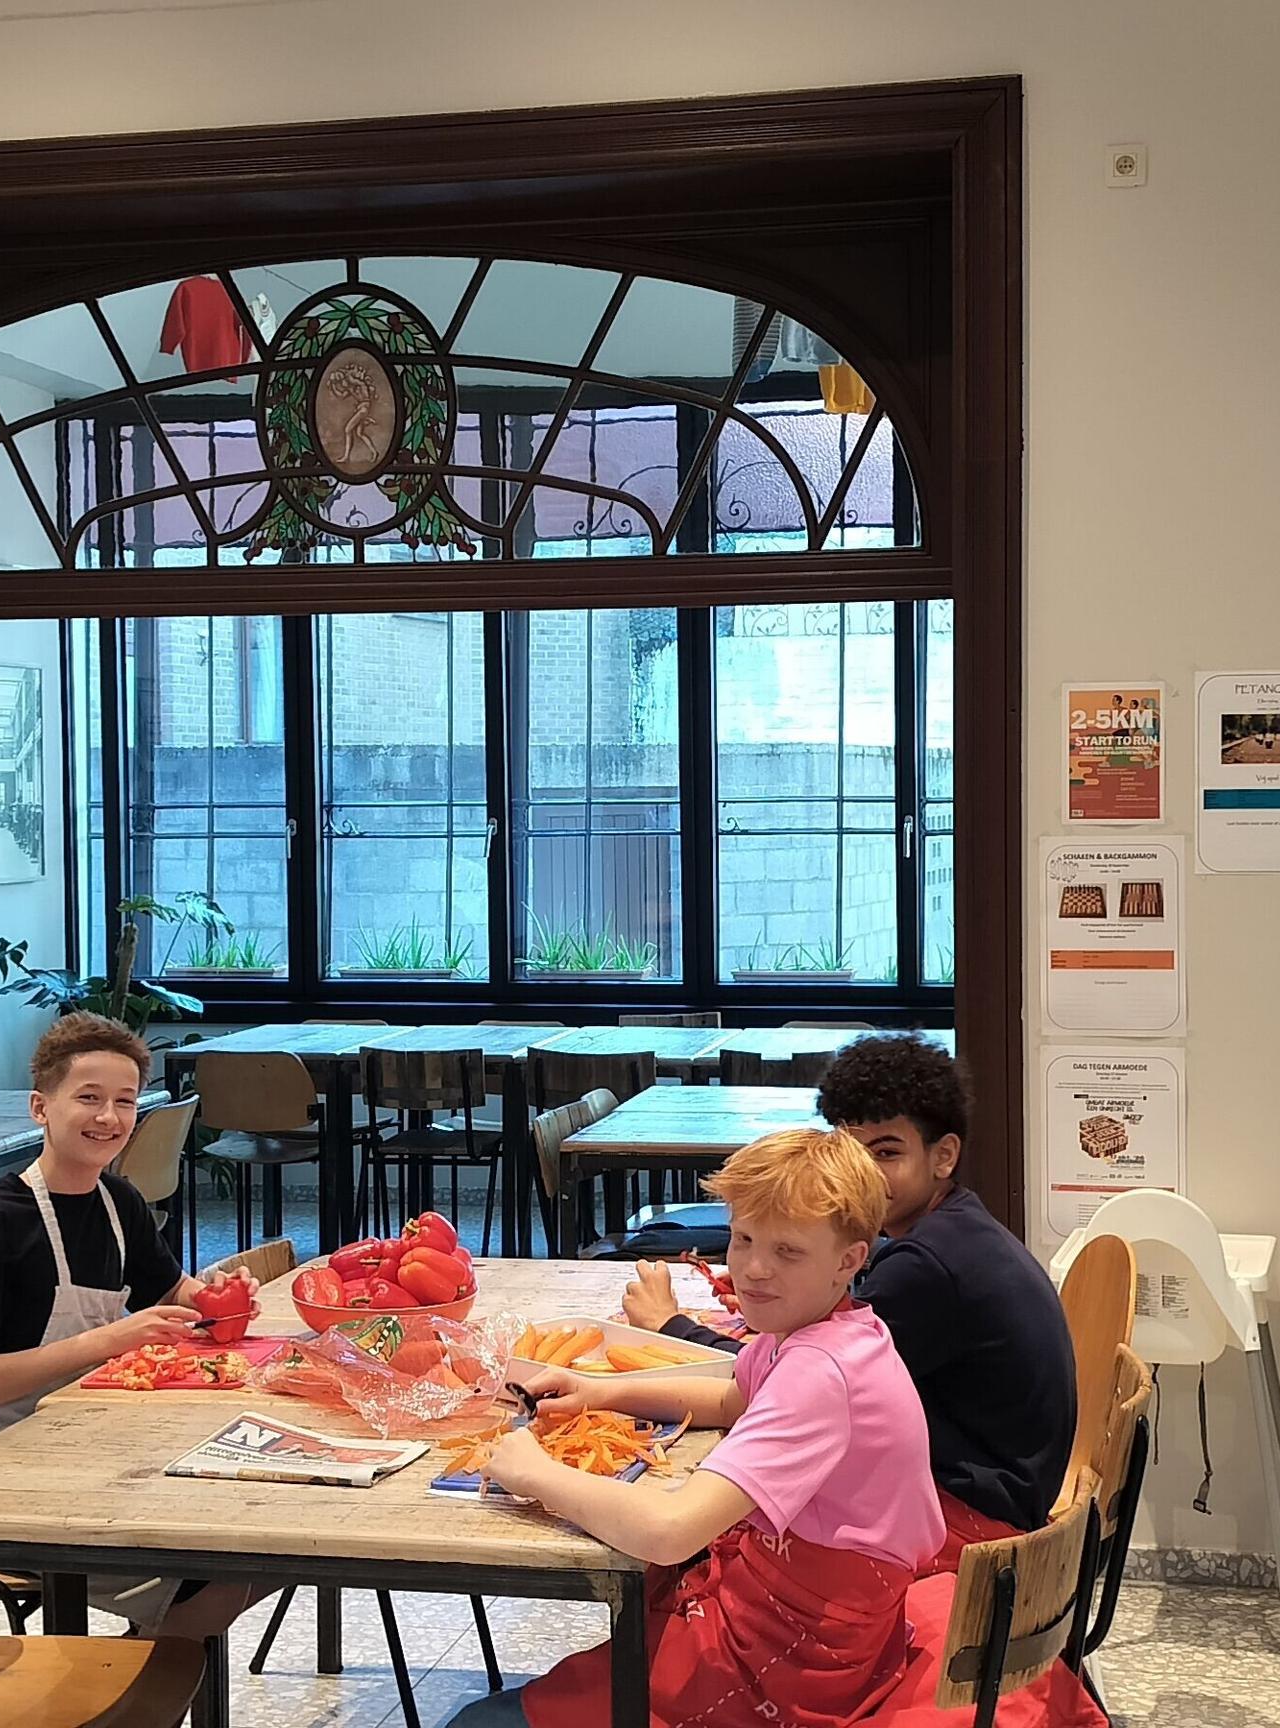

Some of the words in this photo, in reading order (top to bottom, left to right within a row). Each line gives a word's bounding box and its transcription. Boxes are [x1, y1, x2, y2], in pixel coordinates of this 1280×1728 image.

[1071, 709, 1154, 730] 2-5KM
[1075, 737, 1114, 746] START
[1116, 736, 1132, 745] TO
[1134, 736, 1158, 745] RUN
[221, 1421, 282, 1448] N
